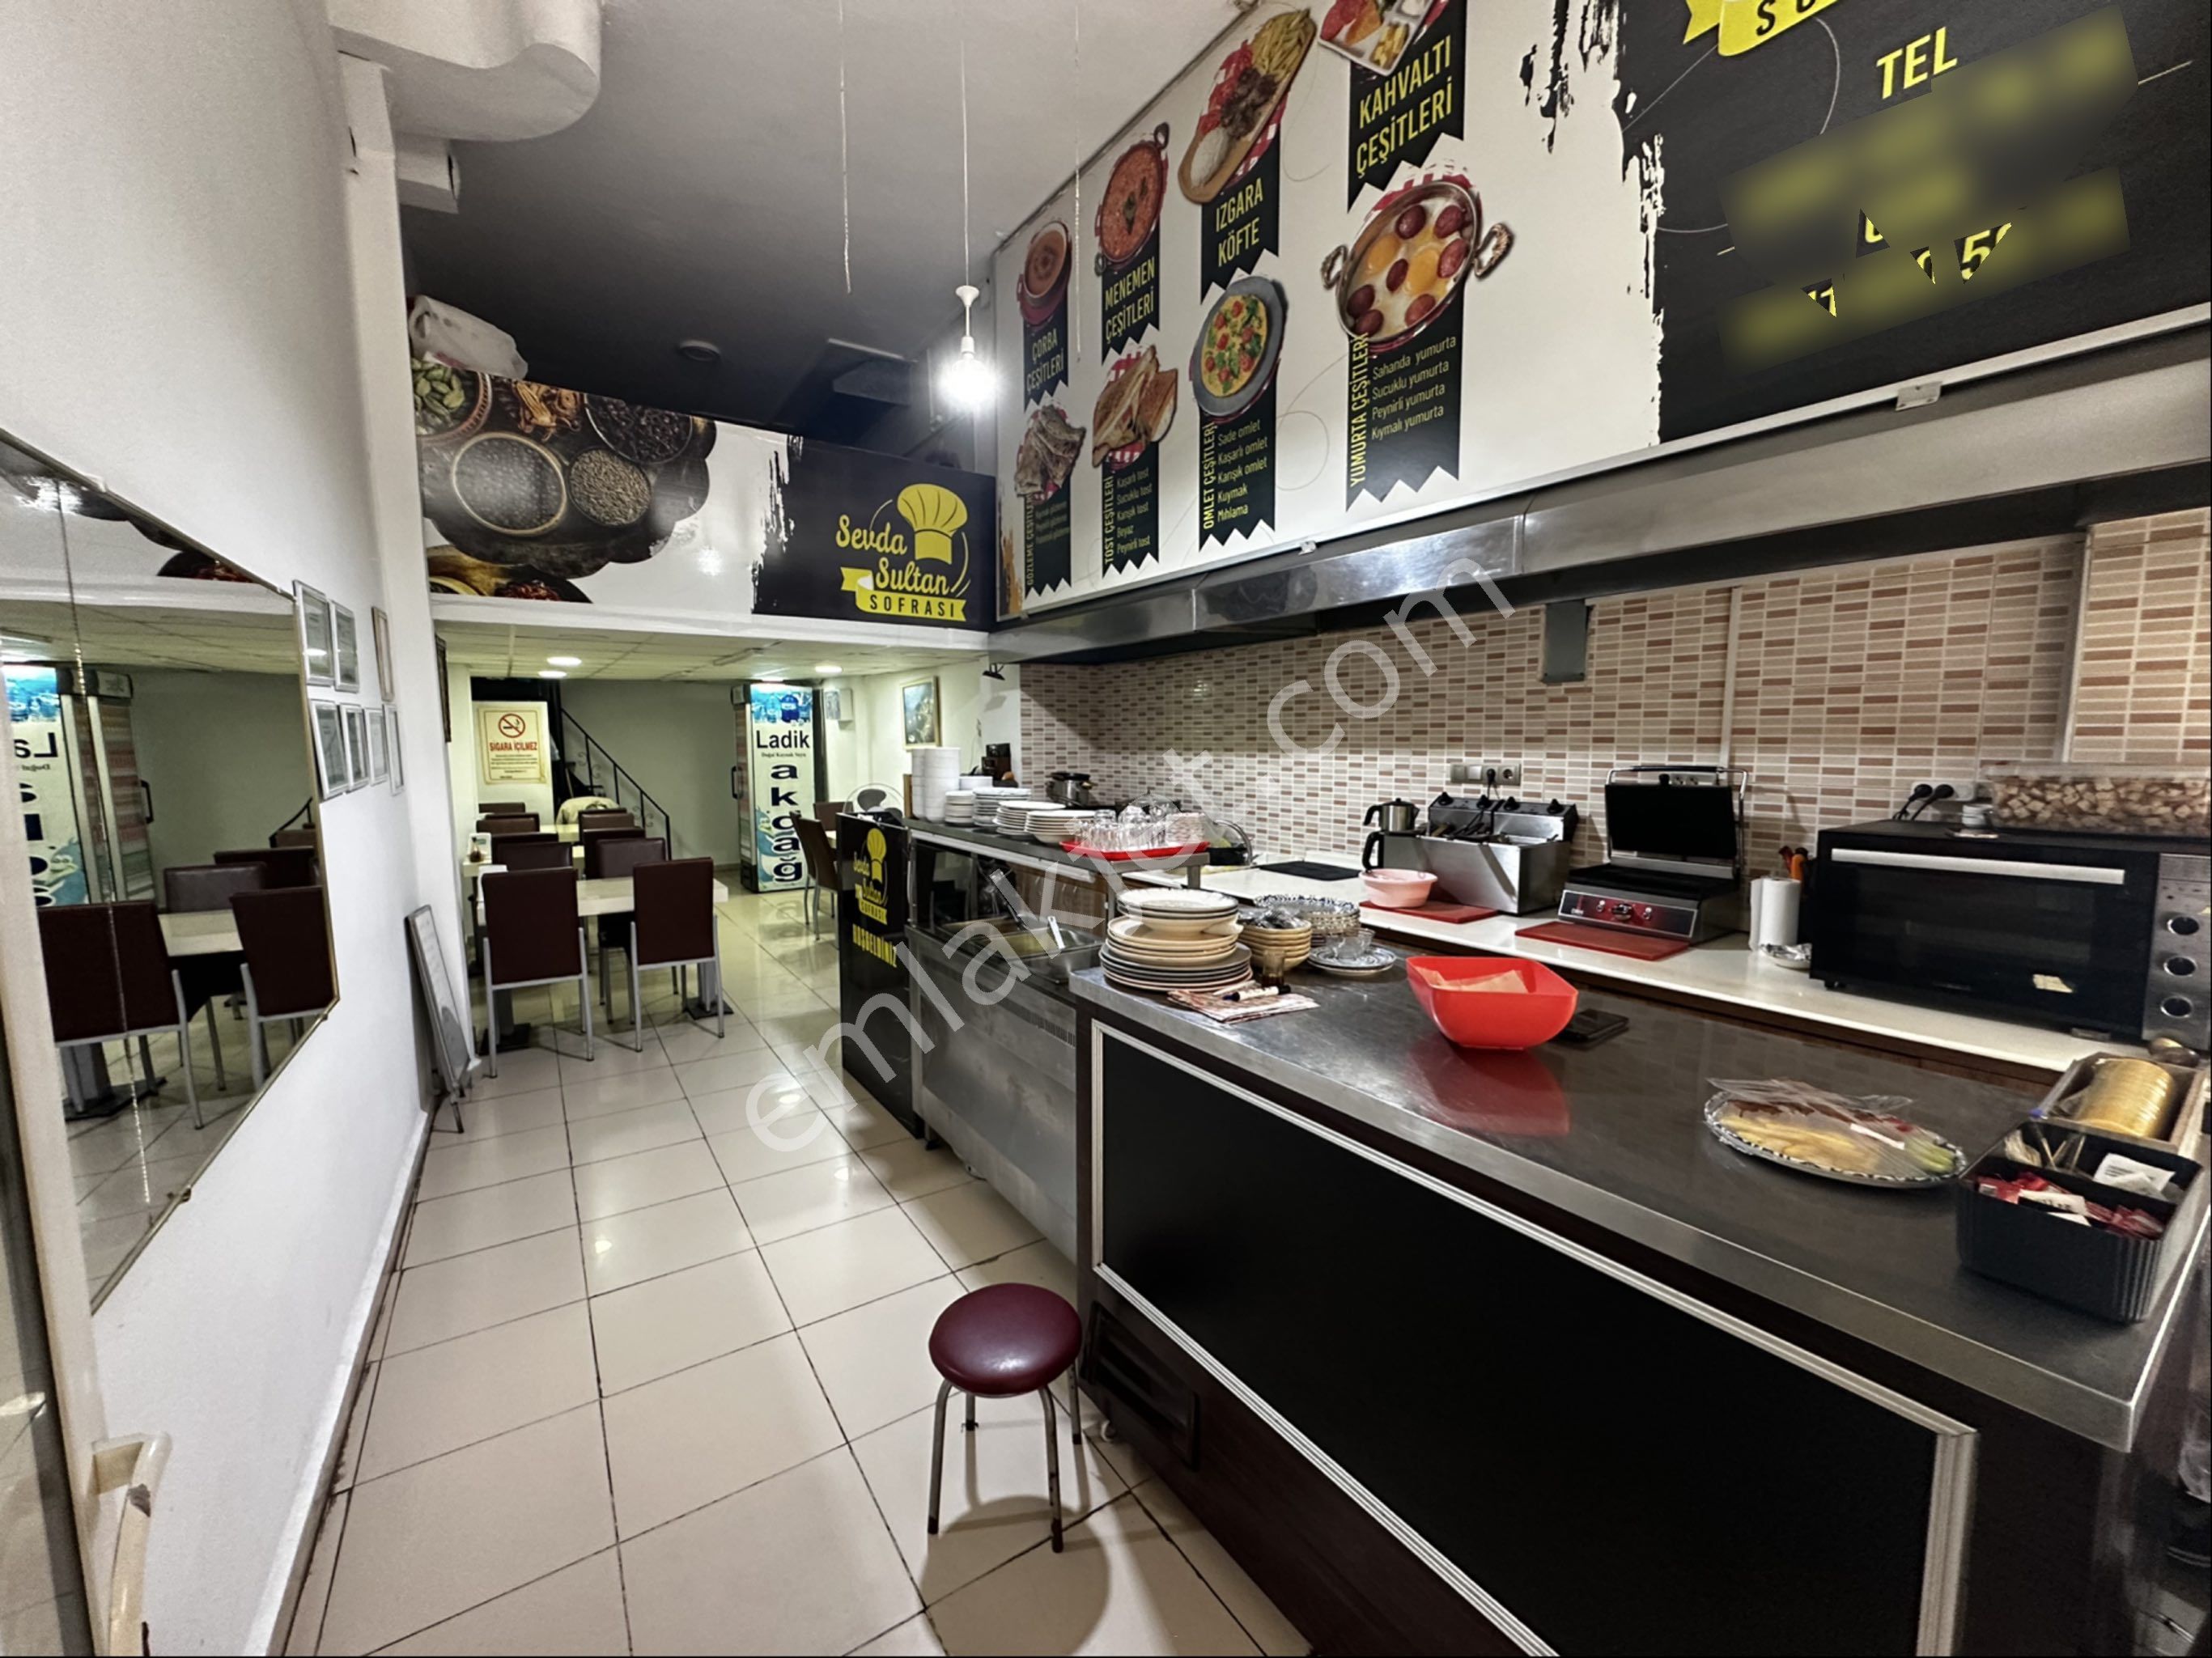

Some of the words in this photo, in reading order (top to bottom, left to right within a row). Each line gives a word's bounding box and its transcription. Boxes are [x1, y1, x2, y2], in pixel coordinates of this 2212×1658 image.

[1360, 36, 1451, 129] KAHVALTI
[1876, 27, 1958, 100] TEL
[1356, 83, 1452, 179] ÇEŞİTLERİ
[1216, 177, 1263, 233] IZGARA
[1218, 217, 1259, 267] KÖFTE
[1105, 257, 1155, 311] MENEMEN
[1106, 286, 1153, 344] ÇEŞİTLERİ
[1033, 328, 1058, 365] ÇORBA
[1373, 354, 1411, 380] Sahanda
[1416, 336, 1456, 365] yumurta
[1026, 348, 1064, 395] ÇEŞİTLERİ
[1373, 376, 1407, 400] Sucuklu
[1408, 361, 1449, 388] yumurta
[1372, 398, 1403, 420] Peynirli
[1405, 384, 1445, 410] yumurta
[1218, 430, 1237, 446] Sade
[1238, 419, 1260, 438] omlet
[1371, 418, 1403, 440] Kıymalı
[1404, 405, 1444, 432] yumurta
[1202, 422, 1217, 486] ÇEŞİTLERİ
[1218, 446, 1243, 465] Kaşarlı
[1245, 436, 1267, 455] omlet
[1350, 412, 1367, 487] YUMURTA
[1218, 465, 1243, 484] Karışık
[1244, 456, 1267, 475] omlet
[1204, 488, 1214, 529] OMLET
[1218, 483, 1248, 503] Kuymak
[836, 515, 907, 554] Sevda
[1105, 536, 1114, 564] TOST
[876, 557, 949, 595] Sultan
[870, 595, 954, 617] SOFRASI
[756, 730, 810, 748] Ladik
